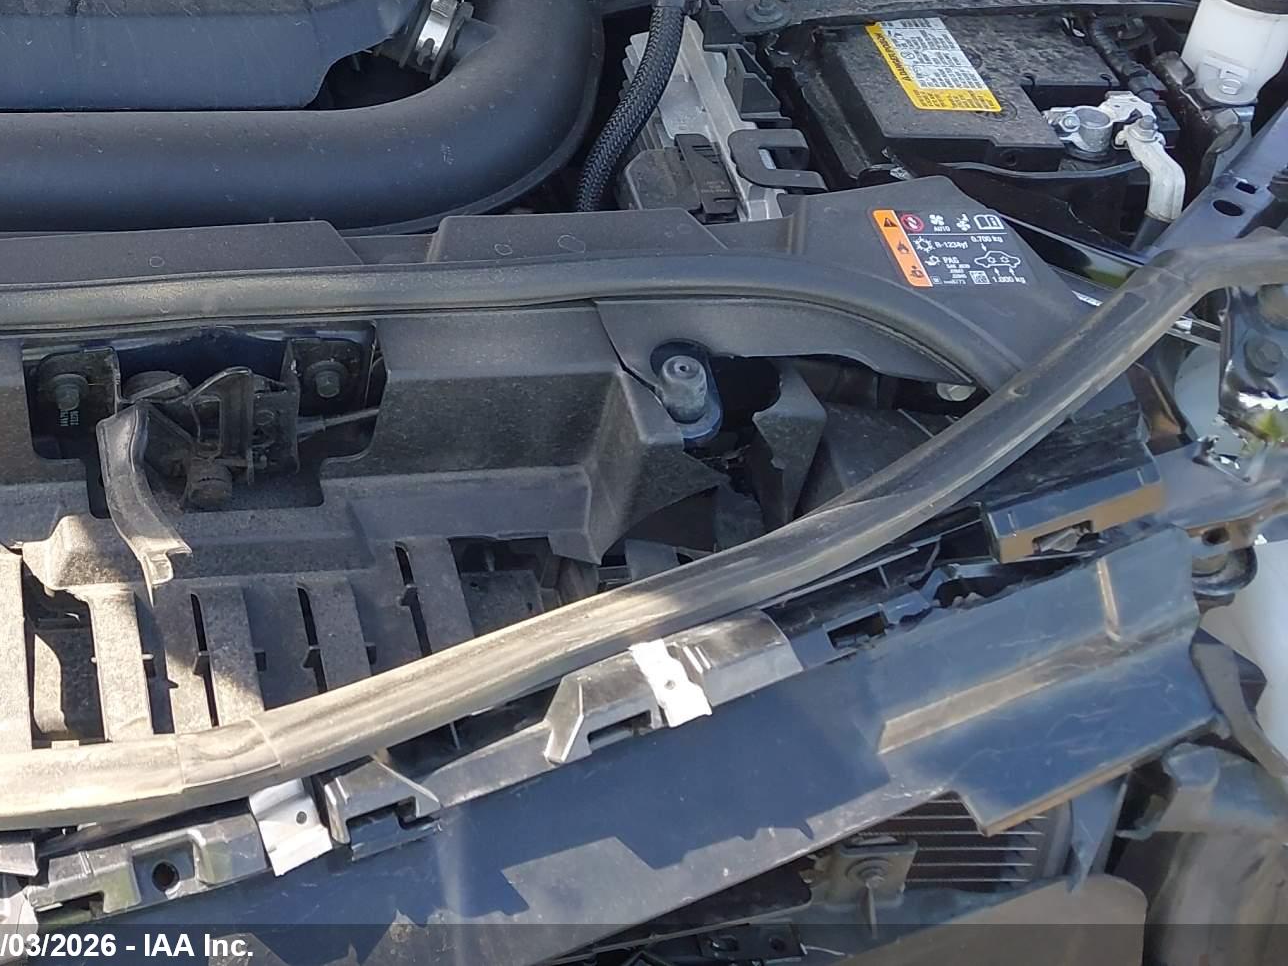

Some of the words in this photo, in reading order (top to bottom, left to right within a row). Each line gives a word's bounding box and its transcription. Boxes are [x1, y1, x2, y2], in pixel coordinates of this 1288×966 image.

[992, 235, 1004, 243] kg
[934, 241, 969, 249] R-1234yf
[1015, 275, 1027, 284] kg
